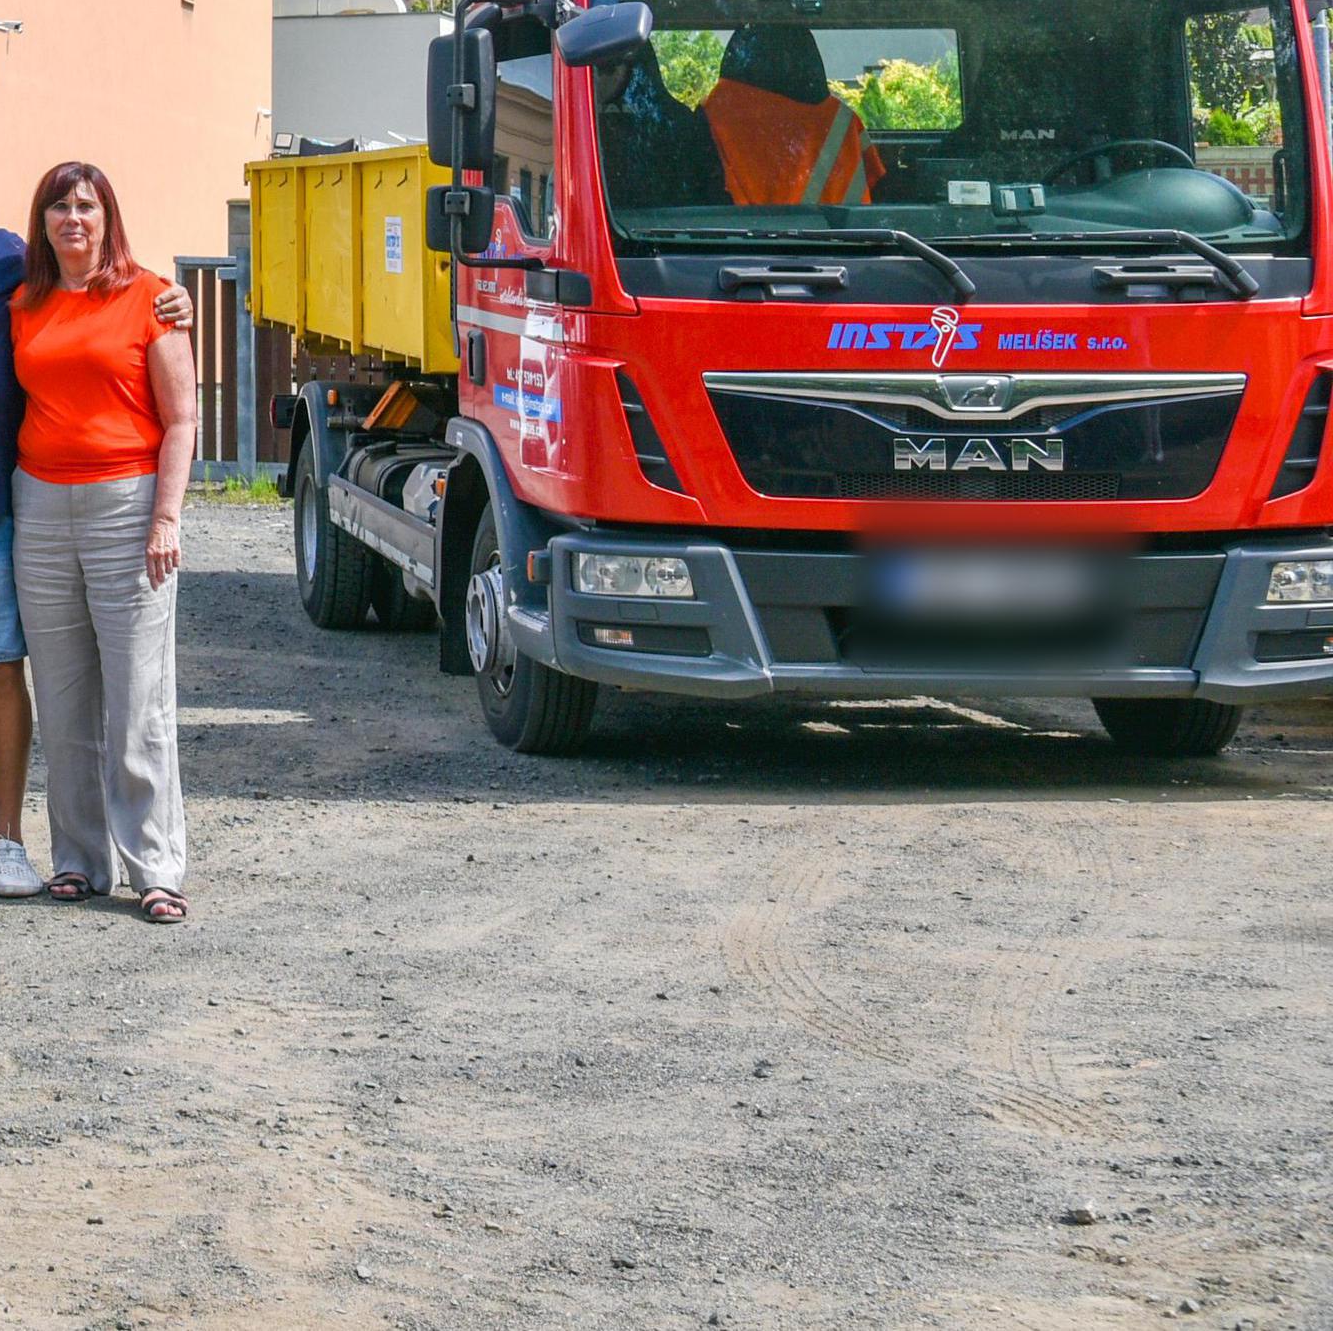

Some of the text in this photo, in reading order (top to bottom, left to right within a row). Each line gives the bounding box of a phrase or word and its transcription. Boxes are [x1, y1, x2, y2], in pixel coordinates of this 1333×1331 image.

[1000, 129, 1055, 140] MAN
[827, 322, 1129, 350] INSTAS MELÍŠEK s.r.o.
[893, 437, 1064, 470] MAN
